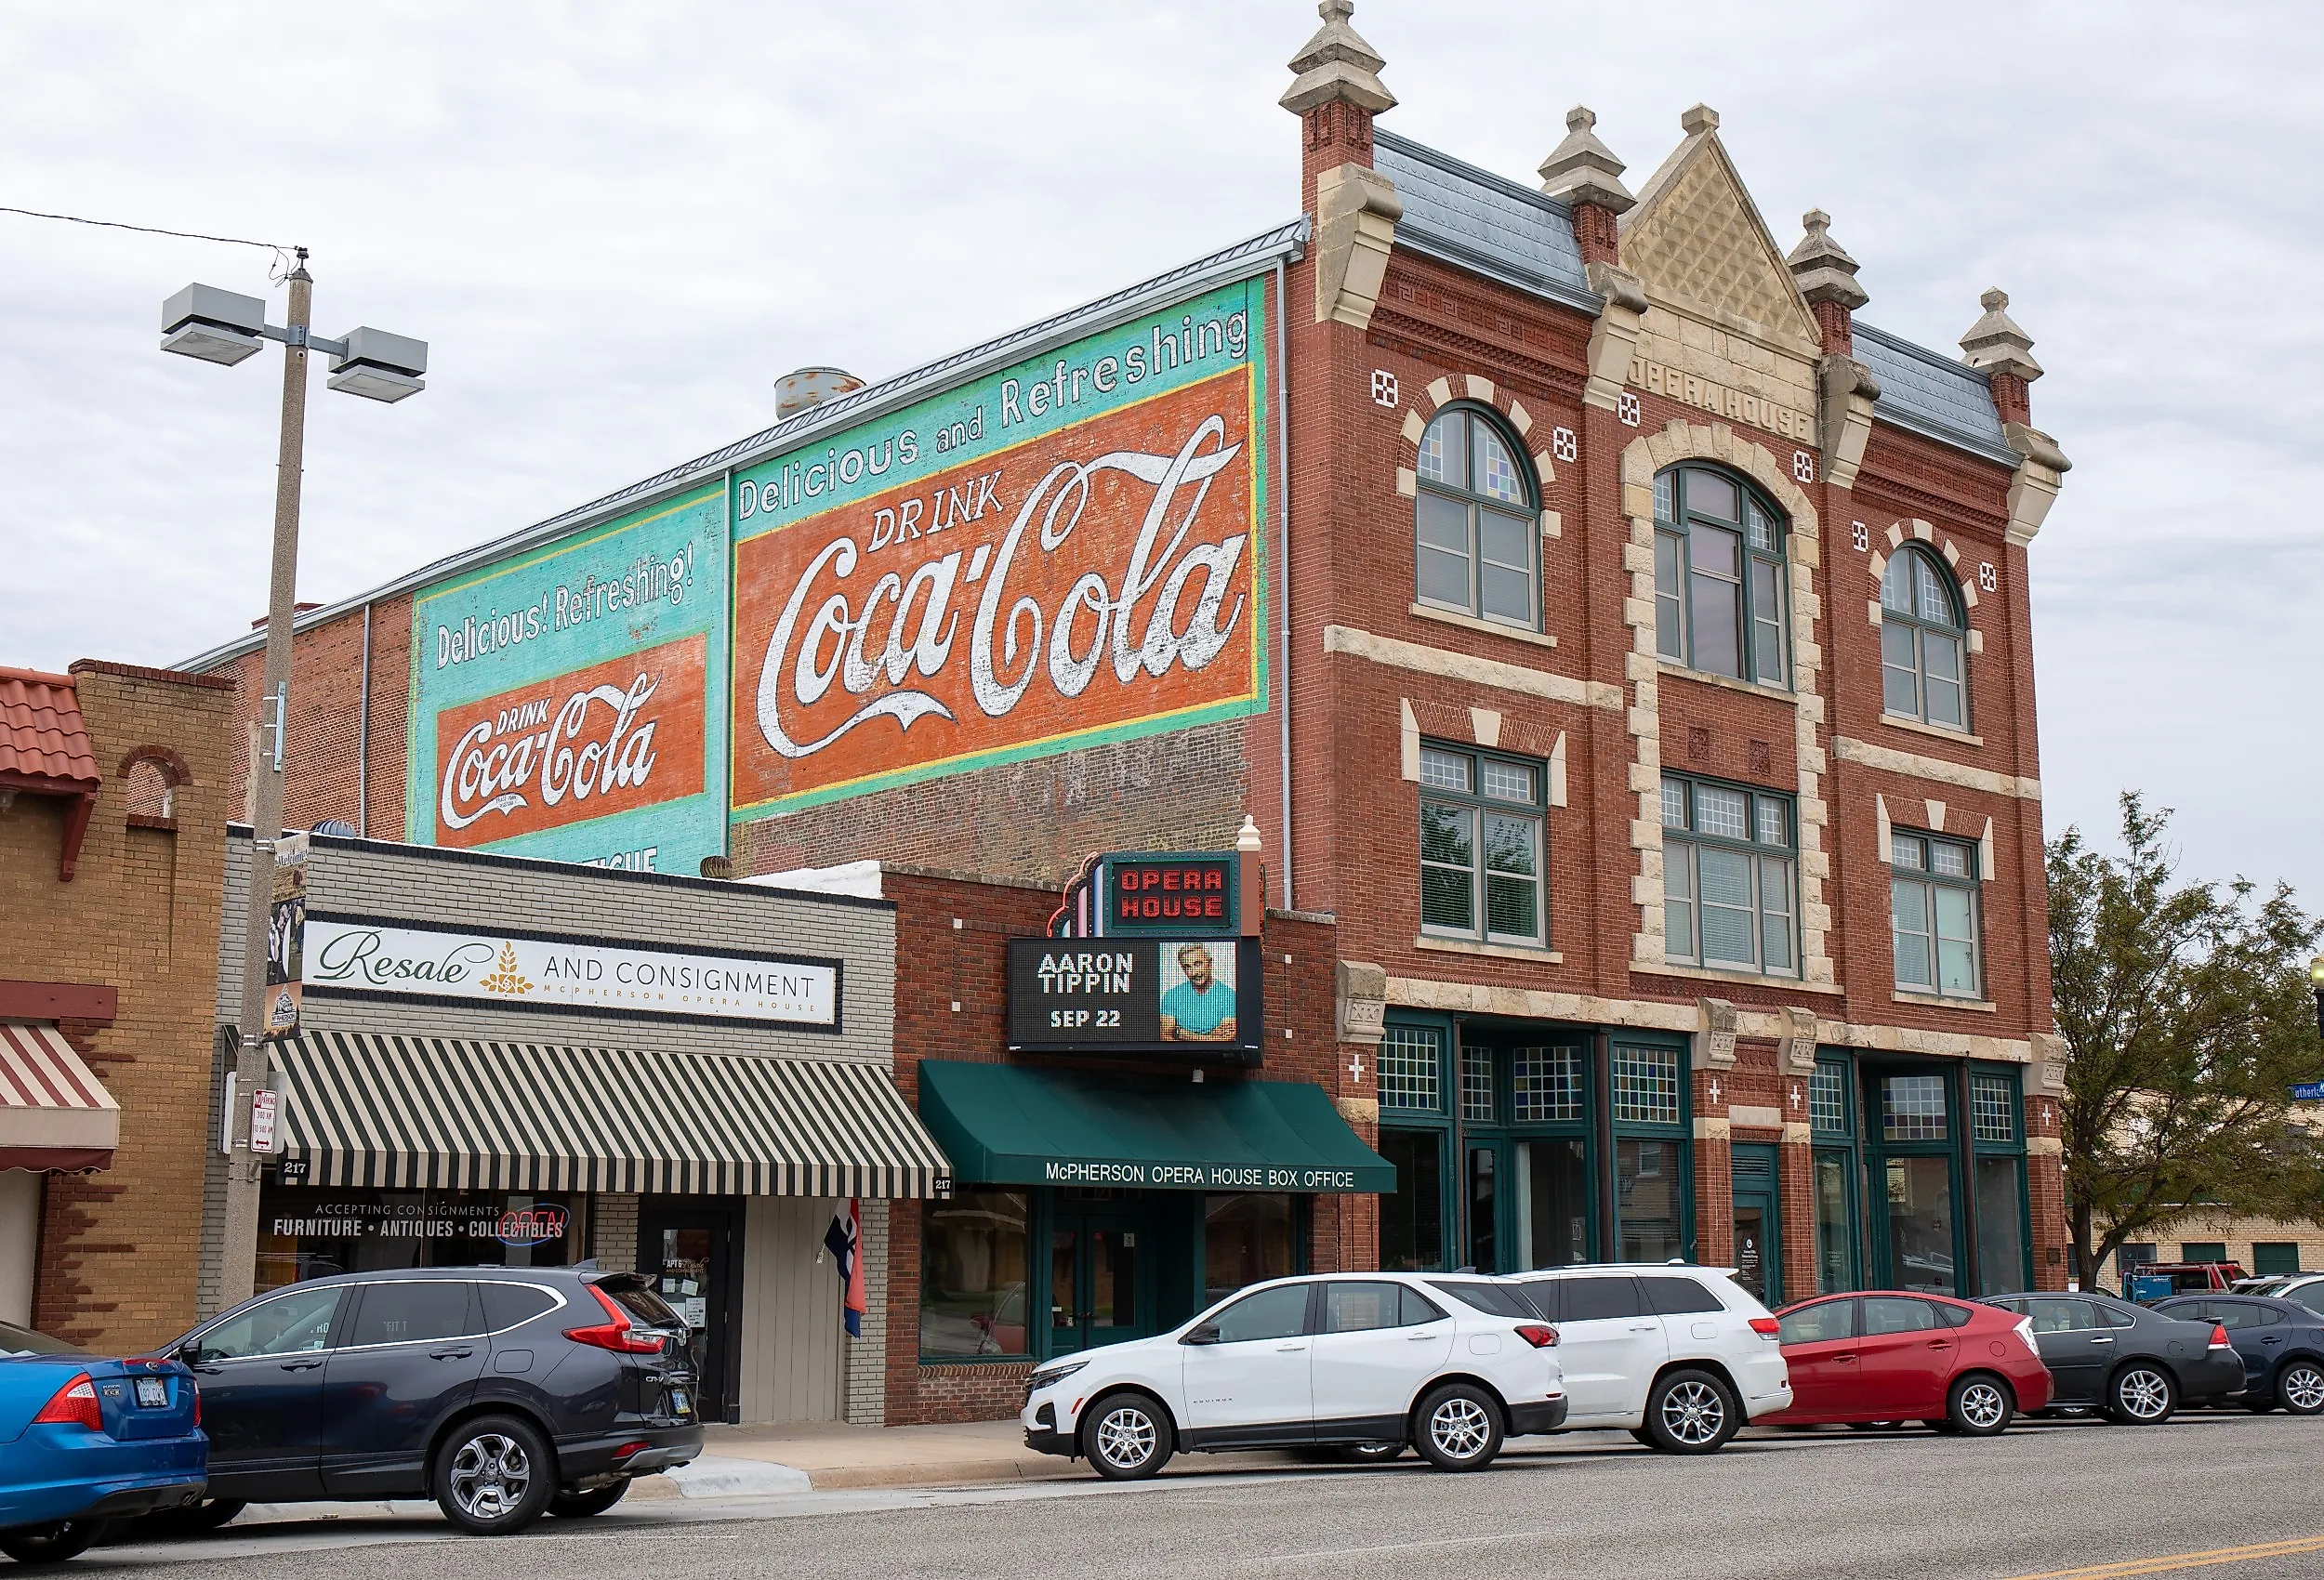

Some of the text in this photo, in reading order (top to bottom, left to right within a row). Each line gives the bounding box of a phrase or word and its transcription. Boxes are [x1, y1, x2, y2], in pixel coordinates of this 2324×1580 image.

[737, 309, 1248, 521] Delicious and Refreshing
[1723, 388, 1811, 442] HOUSE
[866, 470, 1005, 554] DRINK
[757, 415, 1249, 759] Coca-Cola
[437, 540, 693, 671] Delicious! Refreshing!
[495, 697, 552, 736] DRINK
[442, 669, 663, 831] Coca-Cola
[1121, 869, 1222, 891] OPERA
[1121, 895, 1223, 918] HOUSE
[312, 929, 495, 985] Resale
[1037, 953, 1133, 974] AARON
[544, 955, 814, 998] AND CONSIGNMENT
[1037, 972, 1130, 994] TIPPIN
[544, 984, 815, 1012] MCPHERSON OPERA HOUSE
[1050, 1009, 1121, 1028] SEP 22
[283, 1162, 307, 1175] 217
[1045, 1163, 1354, 1188] McPHERSON OPERA HOUSE BOX OFFICE
[935, 1179, 951, 1191] 217
[315, 1204, 500, 1217] ACCEPTING CONSIGNMENTS
[273, 1218, 563, 1238] FURNITURE ANTIQUES COLLECTIBLES
[499, 1211, 565, 1239] OPEN
[667, 1260, 677, 1268] APT
